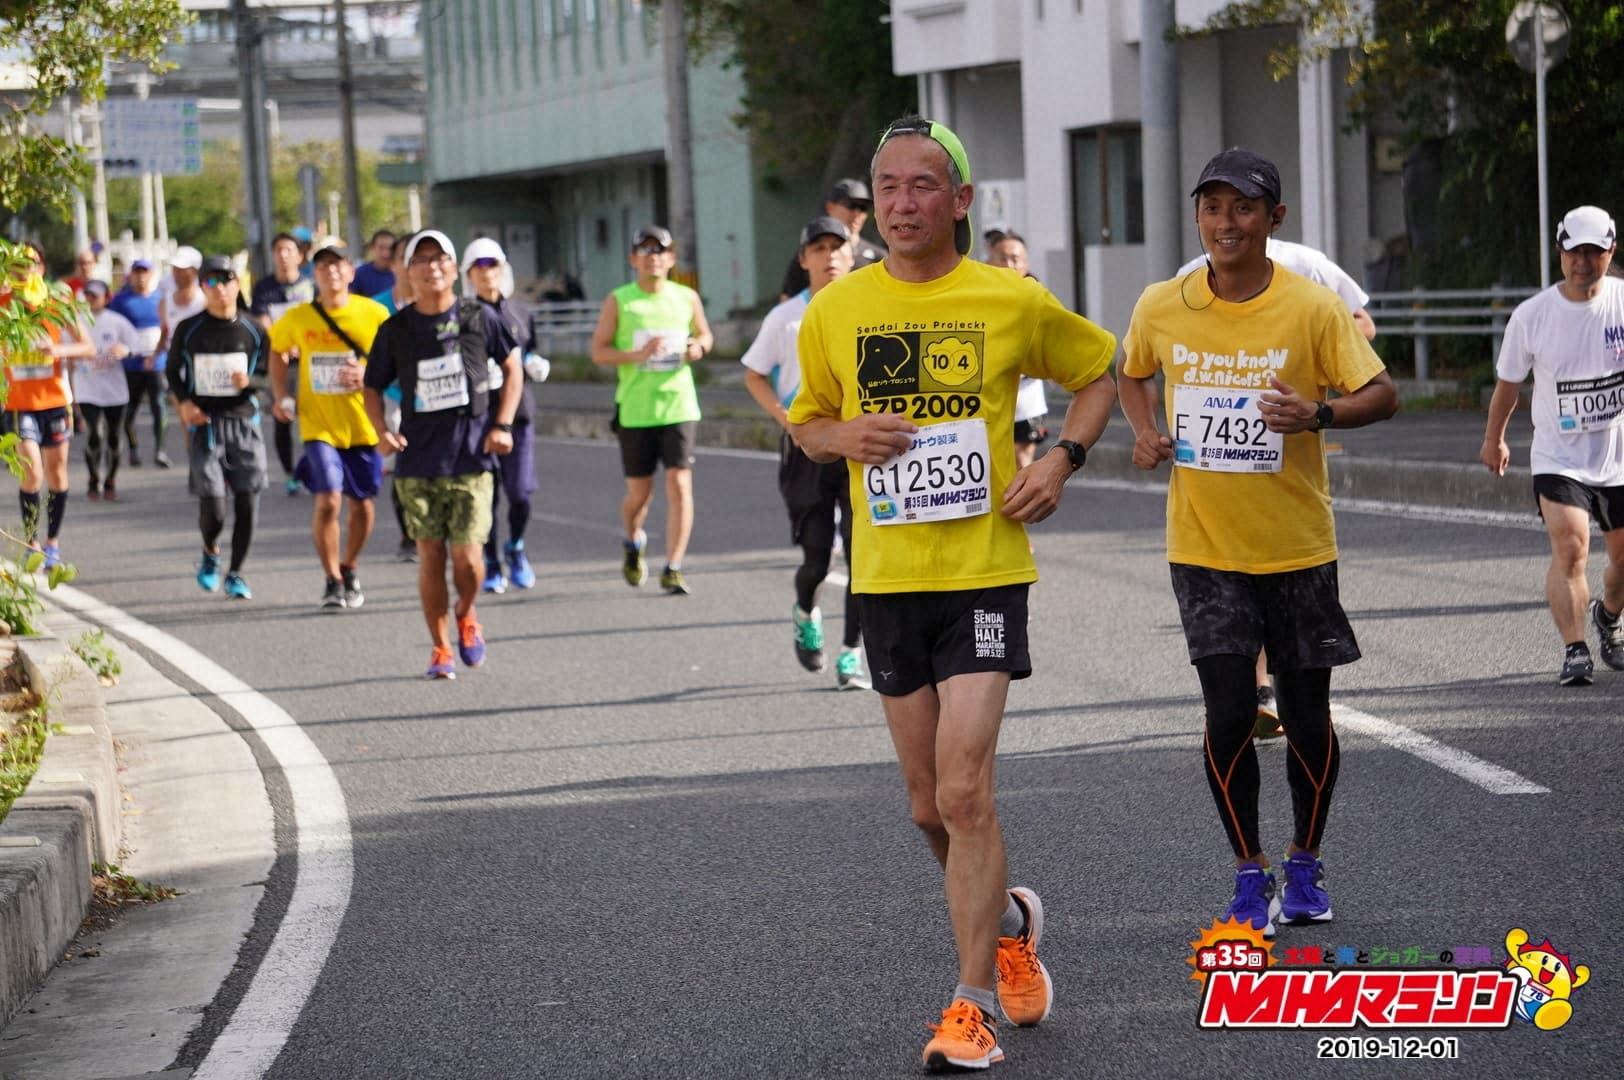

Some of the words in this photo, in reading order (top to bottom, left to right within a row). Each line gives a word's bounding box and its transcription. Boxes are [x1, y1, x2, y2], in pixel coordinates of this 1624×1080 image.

[857, 323, 898, 334] Sendai
[904, 322, 927, 330] Zou
[933, 320, 986, 331] Projeckt
[931, 354, 949, 369] 10
[957, 354, 969, 370] 4
[1172, 343, 1199, 366] Do
[1202, 351, 1235, 370] you
[911, 394, 981, 419] 2009
[1203, 397, 1233, 409] ANA
[1200, 415, 1267, 446] 7432
[867, 451, 985, 497] G12530
[974, 612, 1004, 624] SENDAI
[975, 628, 1005, 642] HALF
